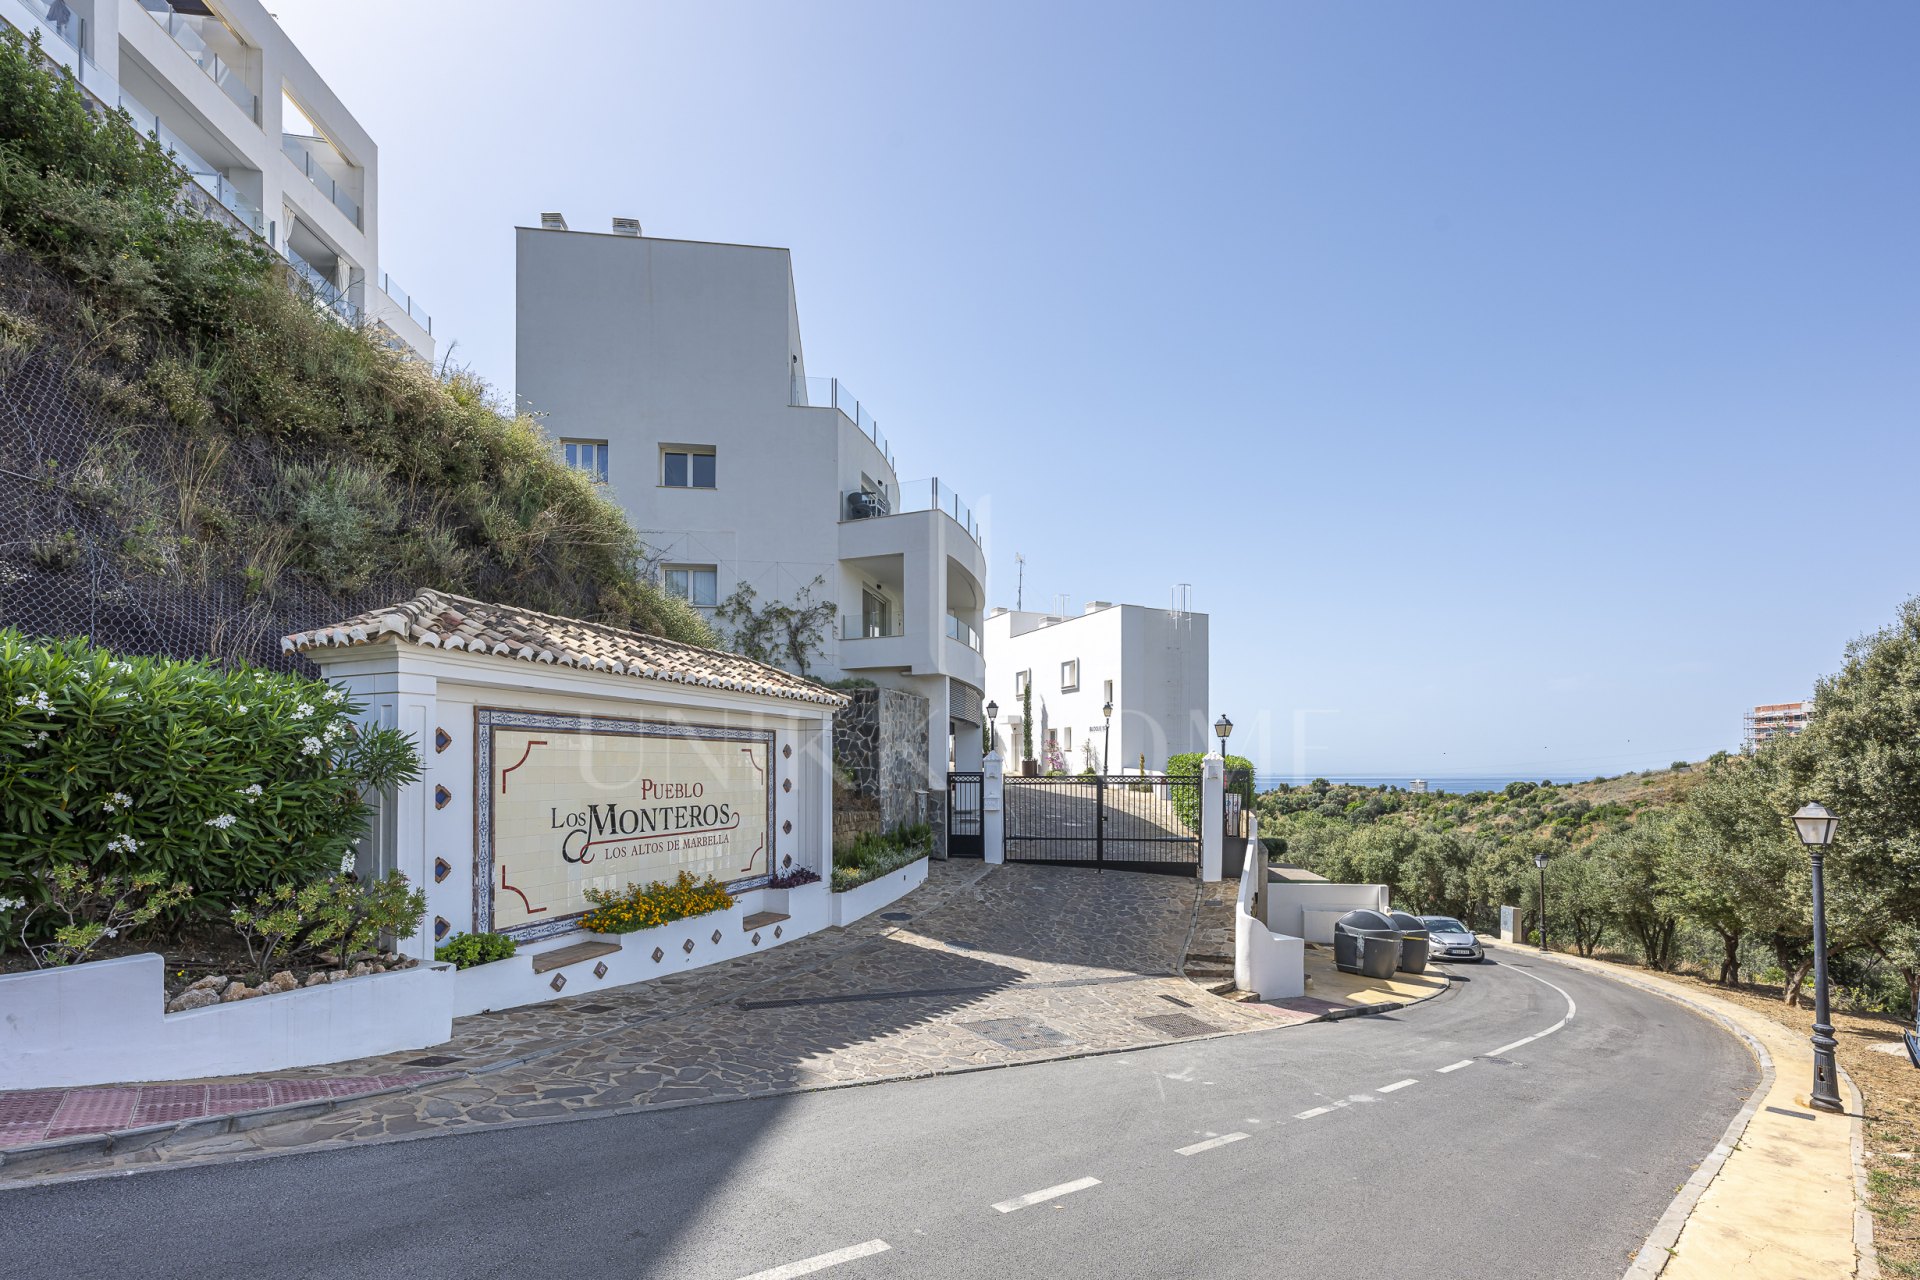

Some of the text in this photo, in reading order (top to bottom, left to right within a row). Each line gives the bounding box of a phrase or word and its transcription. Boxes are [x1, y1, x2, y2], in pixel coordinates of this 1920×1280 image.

[641, 779, 704, 800] PUEBLO
[551, 803, 730, 844] LOS MONTEROS
[605, 834, 730, 860] LOS ALTOS DE MARBELLA
